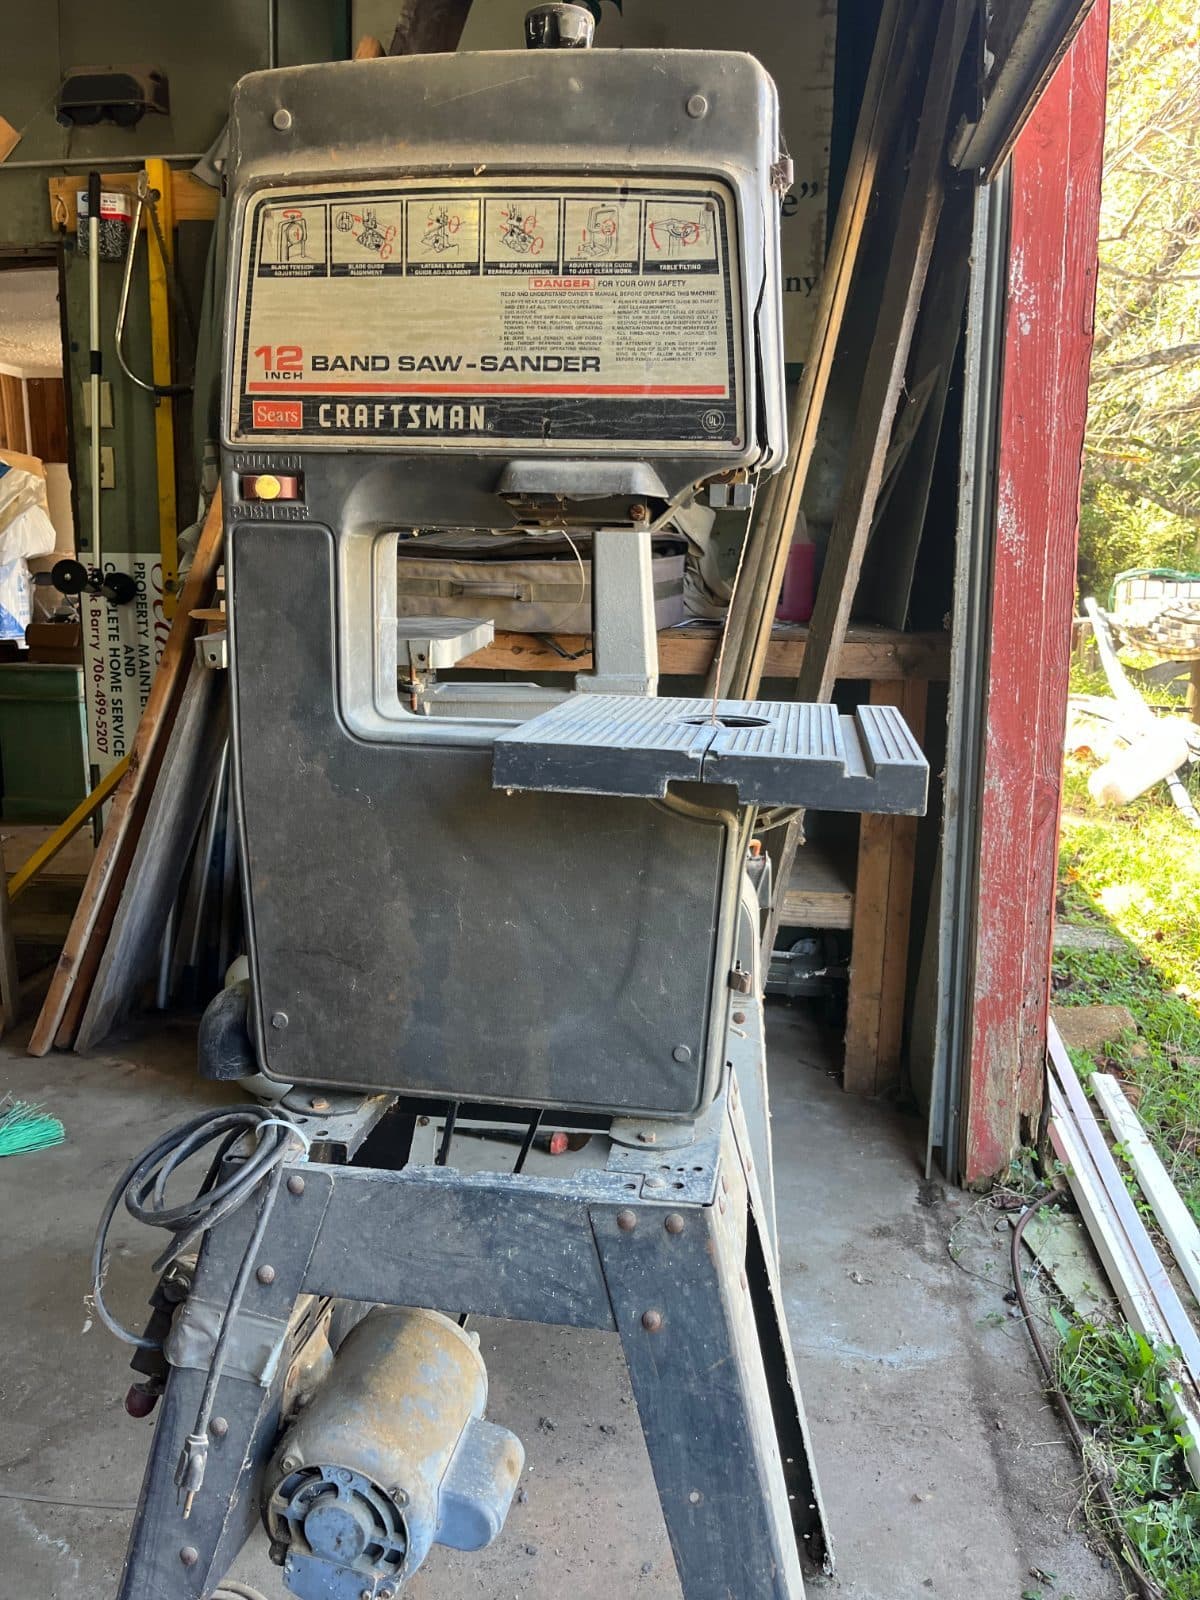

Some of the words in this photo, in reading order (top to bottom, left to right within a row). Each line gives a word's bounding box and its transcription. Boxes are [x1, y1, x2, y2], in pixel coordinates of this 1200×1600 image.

[533, 279, 591, 288] DANGER
[597, 279, 613, 287] FOR
[615, 279, 636, 287] YOUR
[638, 279, 656, 287] OWN
[658, 279, 686, 287] SAFETY
[254, 345, 304, 371] 12
[311, 355, 390, 372] BAND
[265, 371, 304, 380] INCH
[256, 405, 299, 423] Sears
[318, 403, 485, 430] CRAFTSMAN
[103, 562, 120, 642] CPLETE
[133, 562, 150, 638] PROPERTY
[89, 609, 102, 650] Barry
[109, 647, 123, 693] HOME
[123, 645, 136, 678] AND
[92, 657, 109, 755] 706-499-5207
[111, 698, 126, 758] SERVICE
